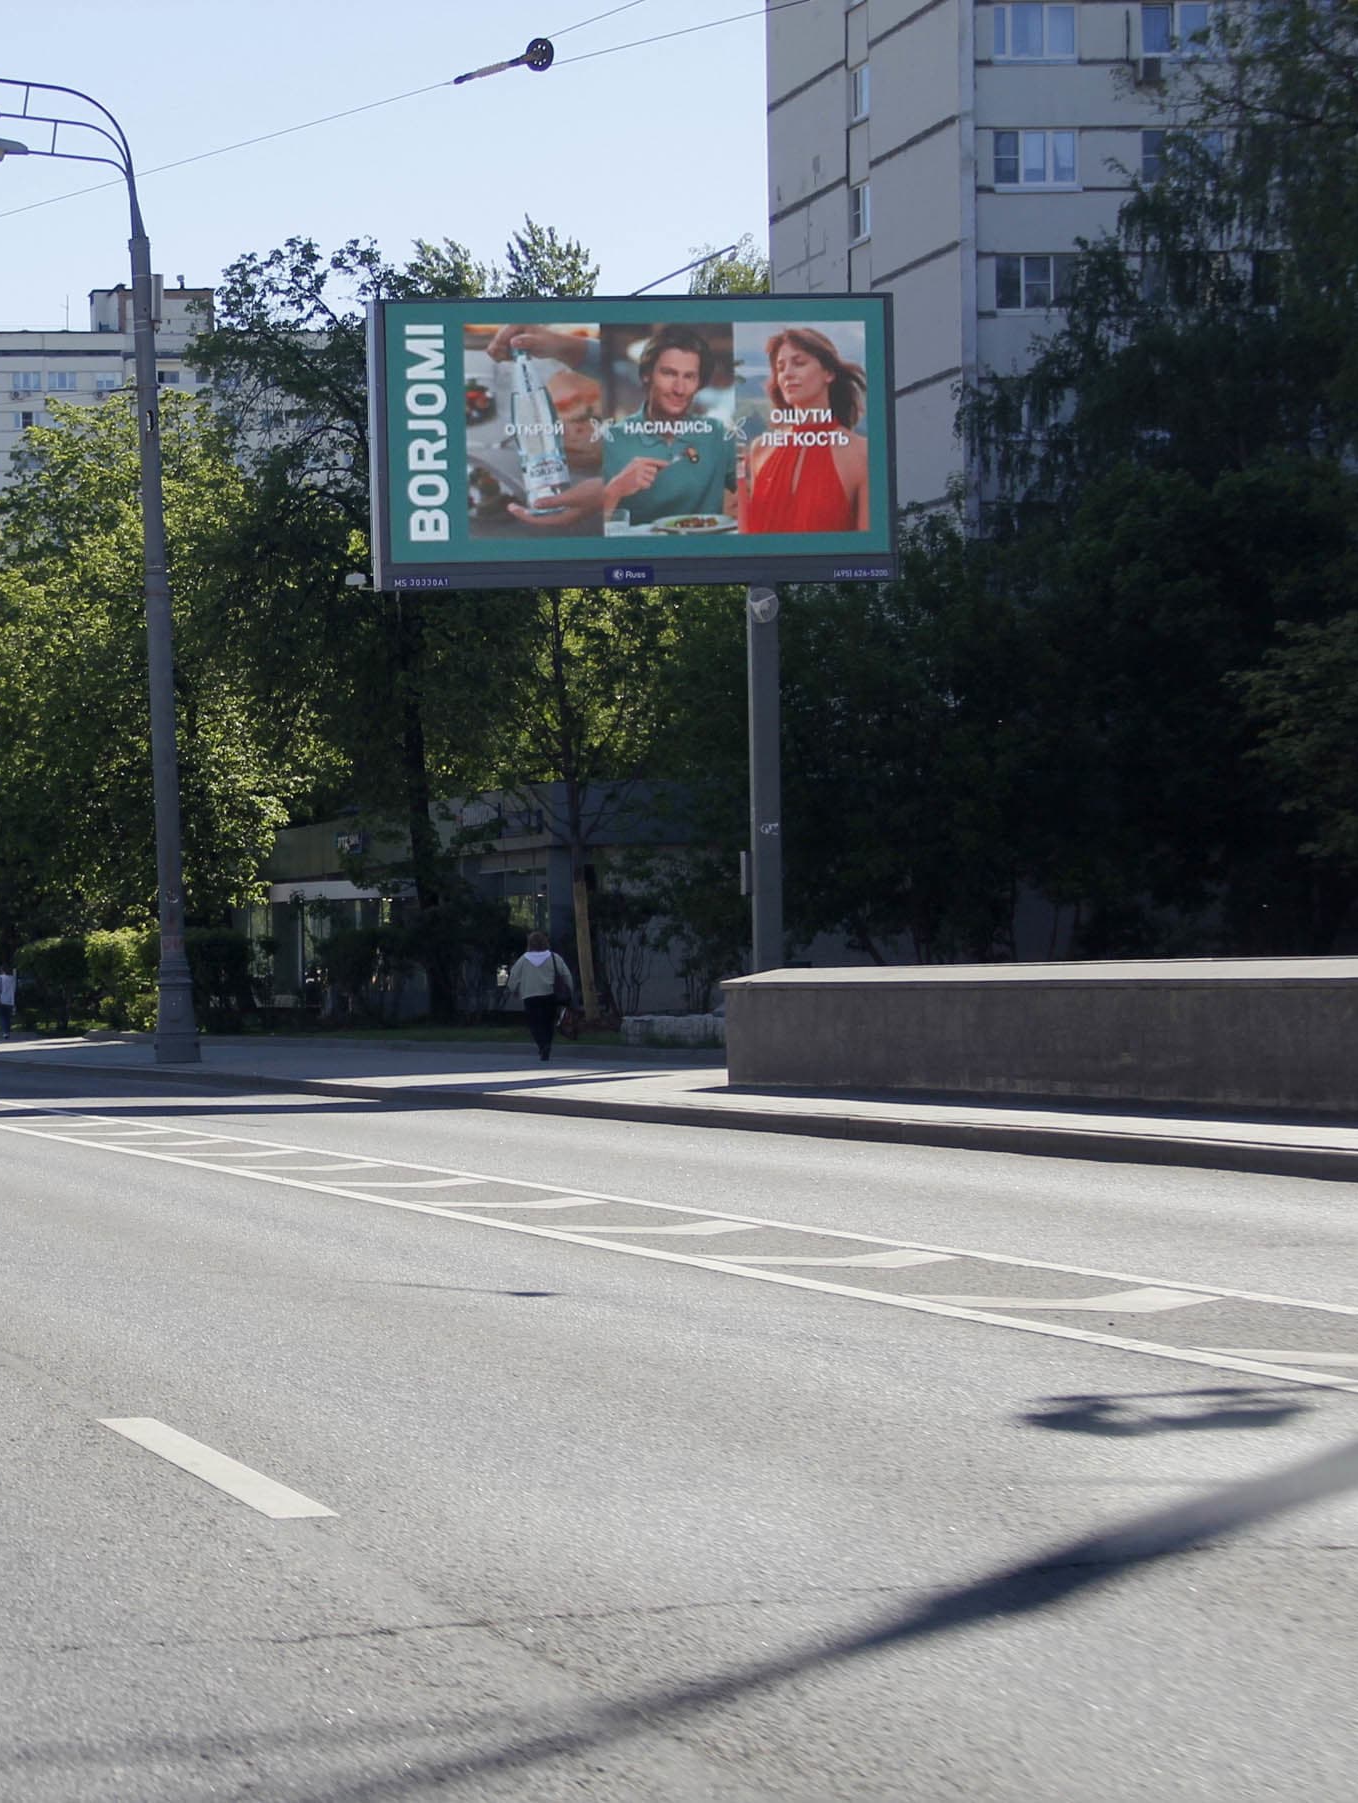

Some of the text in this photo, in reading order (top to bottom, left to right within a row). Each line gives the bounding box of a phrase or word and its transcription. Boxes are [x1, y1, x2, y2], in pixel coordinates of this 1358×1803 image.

[770, 409, 833, 426] ОЩУТИ
[405, 324, 450, 542] BORJOMI
[505, 421, 565, 437] ОТКРОЙ
[624, 420, 713, 435] НАСЛАДИСЬ
[625, 569, 646, 579] Russ
[394, 578, 408, 588] MS
